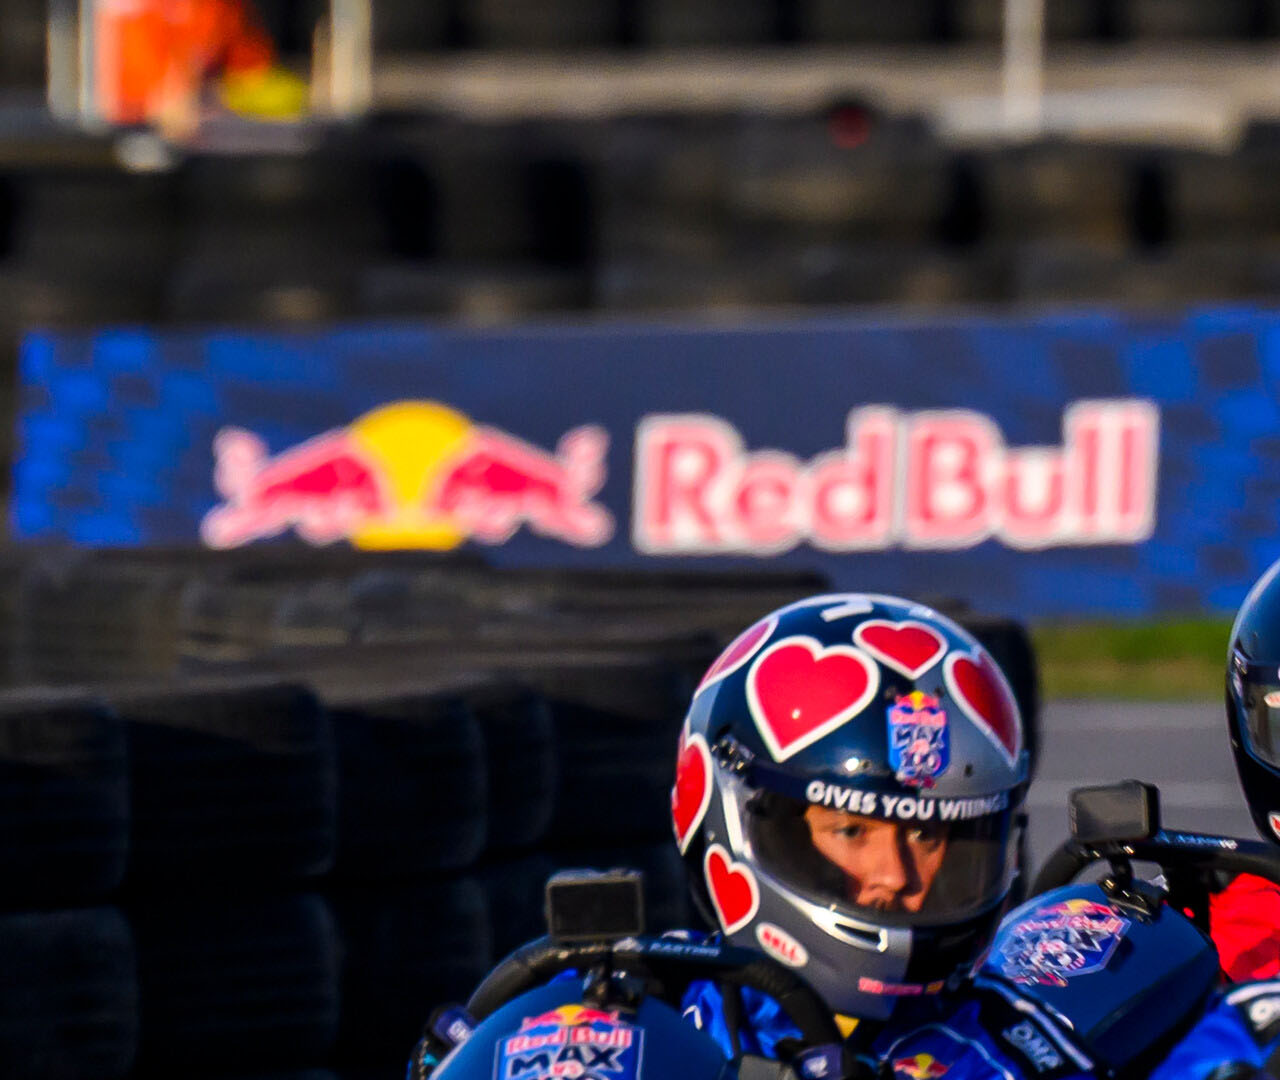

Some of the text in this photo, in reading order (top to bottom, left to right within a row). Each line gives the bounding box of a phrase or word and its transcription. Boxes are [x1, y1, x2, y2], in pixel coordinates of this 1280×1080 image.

[634, 399, 1159, 556] Red Bull
[806, 779, 877, 815] GIVES
[880, 794, 935, 820] YOU
[507, 1025, 633, 1056] Red Bull
[505, 1045, 625, 1080] MAX
